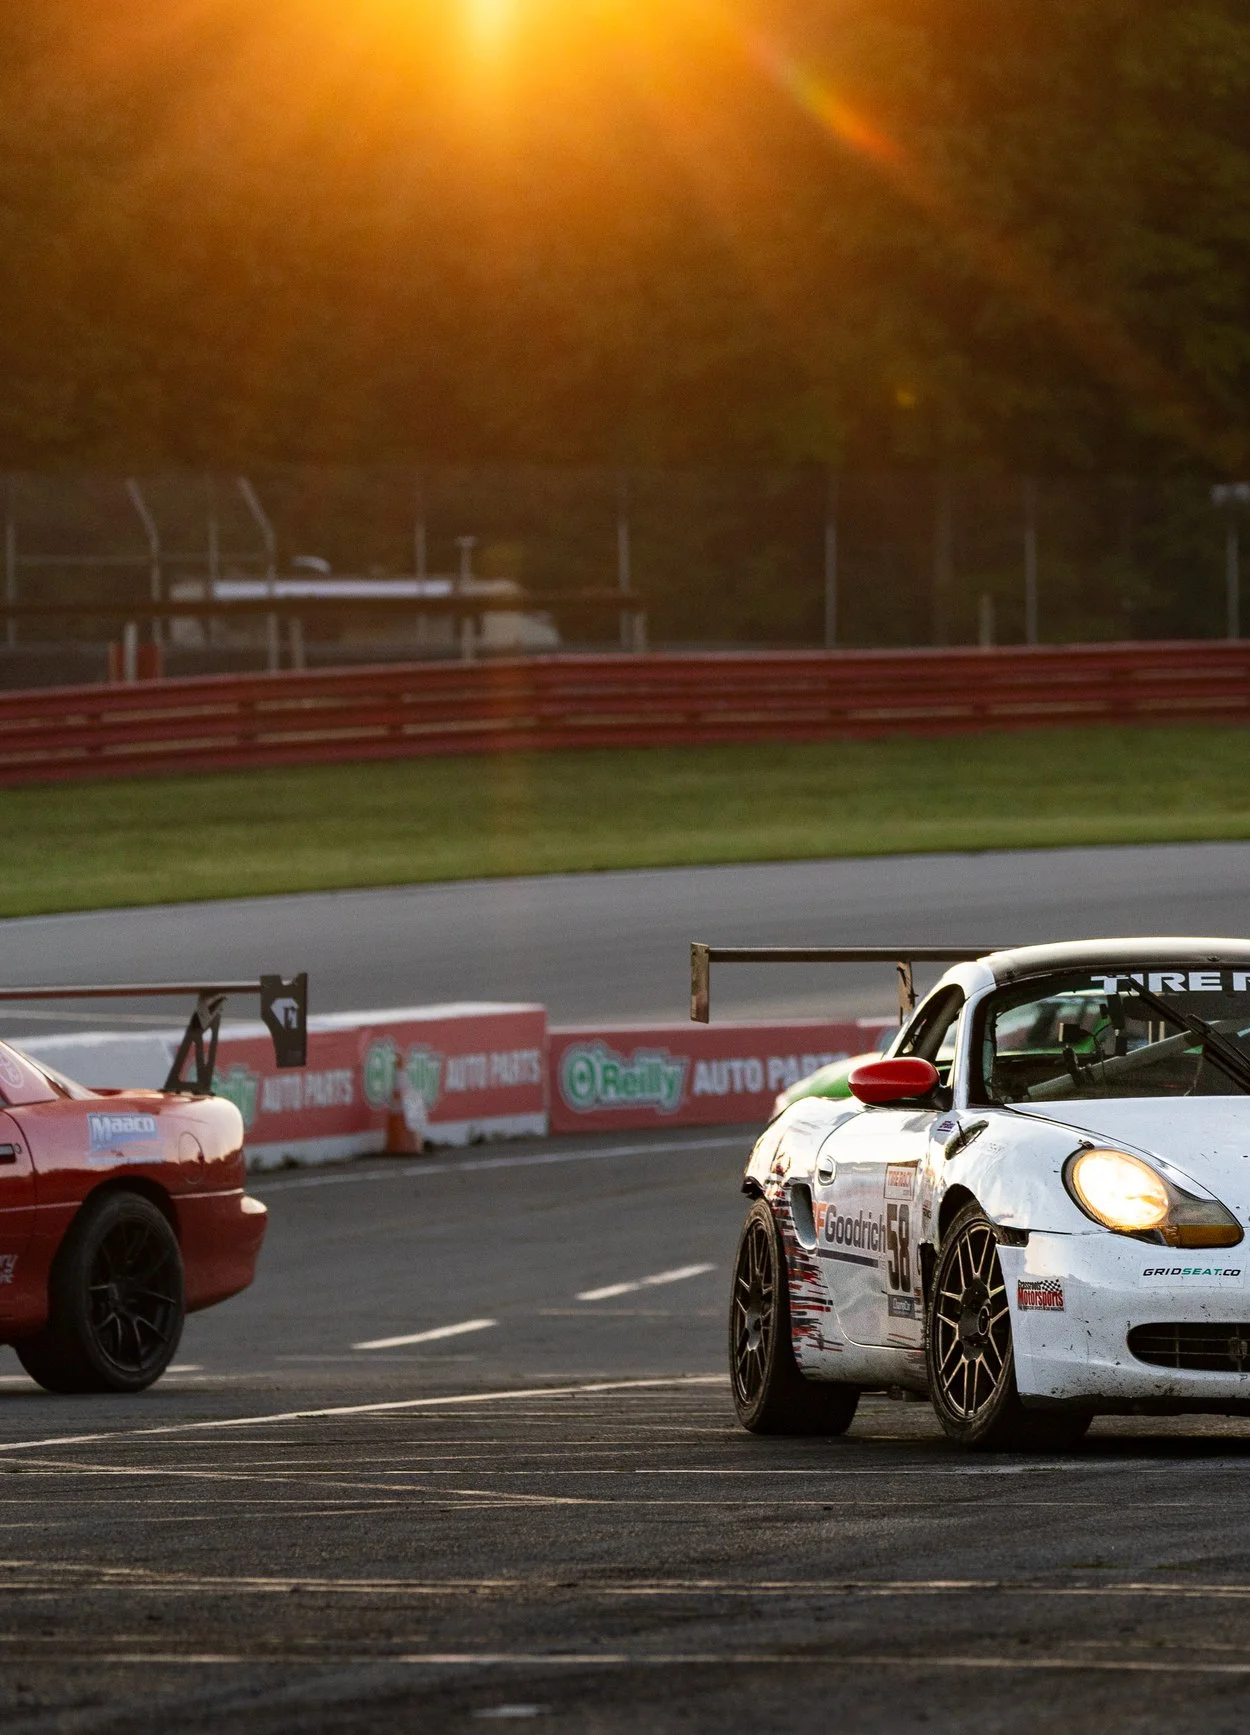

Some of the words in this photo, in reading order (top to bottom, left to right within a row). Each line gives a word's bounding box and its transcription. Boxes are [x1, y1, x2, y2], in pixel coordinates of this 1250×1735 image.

[1091, 971, 1223, 995] TIRE
[565, 1046, 687, 1112] O'Reilly
[692, 1057, 763, 1095] AUTO
[91, 1116, 156, 1141] Maaco
[886, 1203, 911, 1293] 58
[1143, 1267, 1241, 1277] GRIDSEAT.CO
[1017, 1287, 1064, 1307] Motorsports
